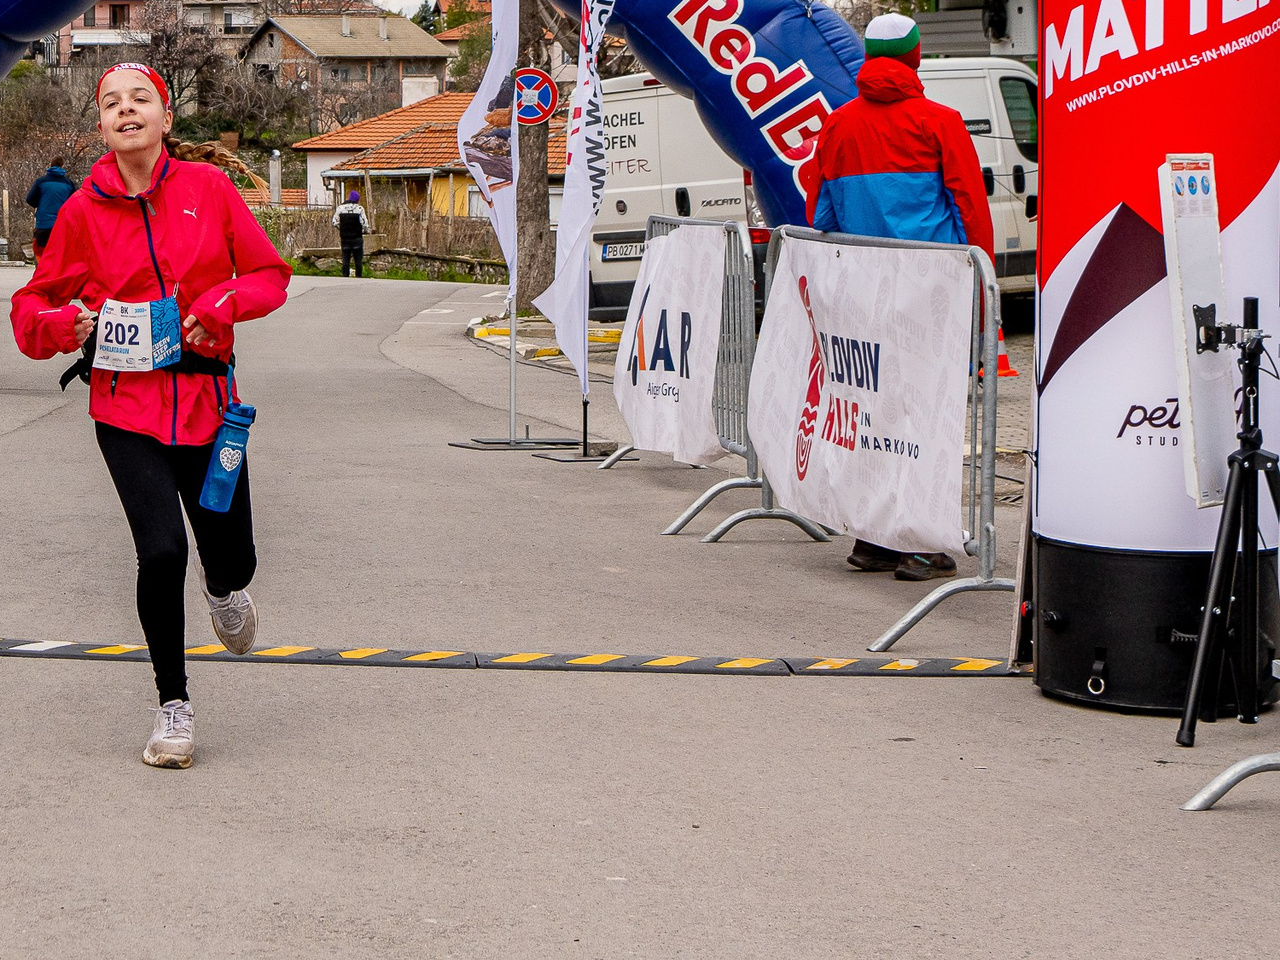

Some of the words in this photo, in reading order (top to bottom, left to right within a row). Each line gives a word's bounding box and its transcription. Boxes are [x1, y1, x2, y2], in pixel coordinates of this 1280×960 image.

[700, 198, 742, 208] DUCATO
[104, 321, 140, 346] 202
[861, 411, 871, 427] IN
[861, 435, 919, 459] MARKOVO
